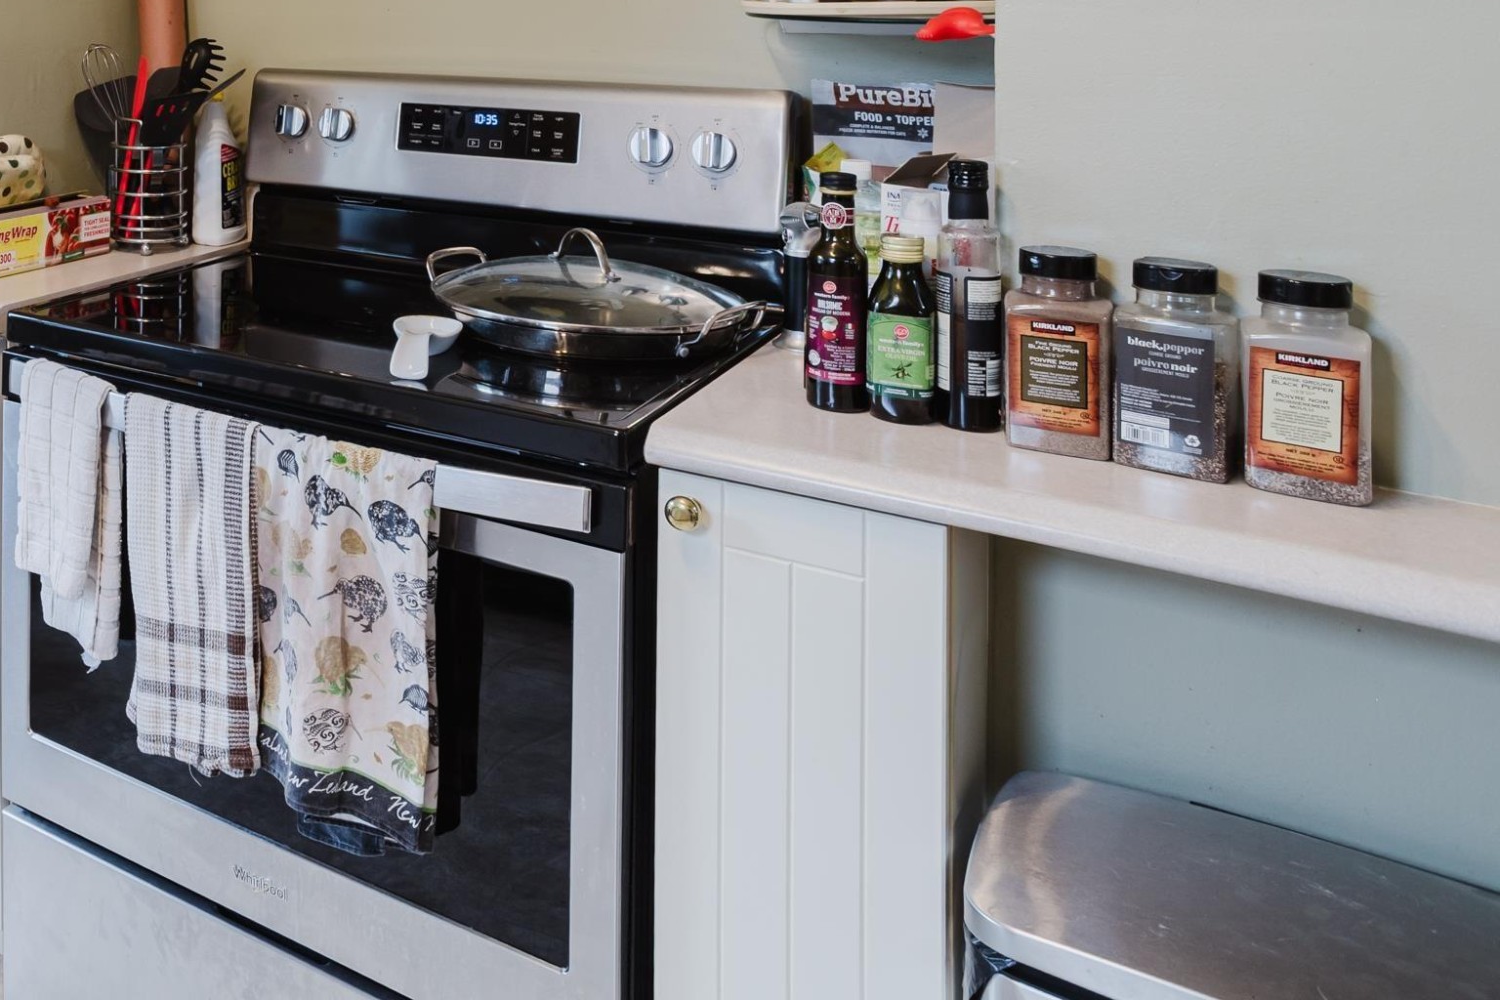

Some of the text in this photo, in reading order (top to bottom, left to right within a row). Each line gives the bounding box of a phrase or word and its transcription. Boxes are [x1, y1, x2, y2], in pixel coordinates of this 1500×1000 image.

[474, 113, 498, 126] 10:35
[854, 111, 883, 123] FOOD
[84, 219, 98, 227] TIGHT
[885, 215, 900, 233] Ti
[84, 228, 110, 237] FRESHNESS
[0, 252, 12, 265] 300
[1032, 321, 1075, 332] KIRKLAND
[1028, 343, 1080, 354] BLACK PEPPER
[1127, 336, 1205, 356] black pepper
[1029, 356, 1057, 364] POIVRE
[1133, 357, 1199, 374] poivre noir
[1278, 353, 1329, 367] KIRKLAND
[1271, 379, 1334, 393] BLACK PEPPER
[1275, 391, 1305, 401] POIVRE
[287, 771, 309, 788] ew
[387, 796, 422, 829] New
[232, 864, 288, 902] Whirlpool
